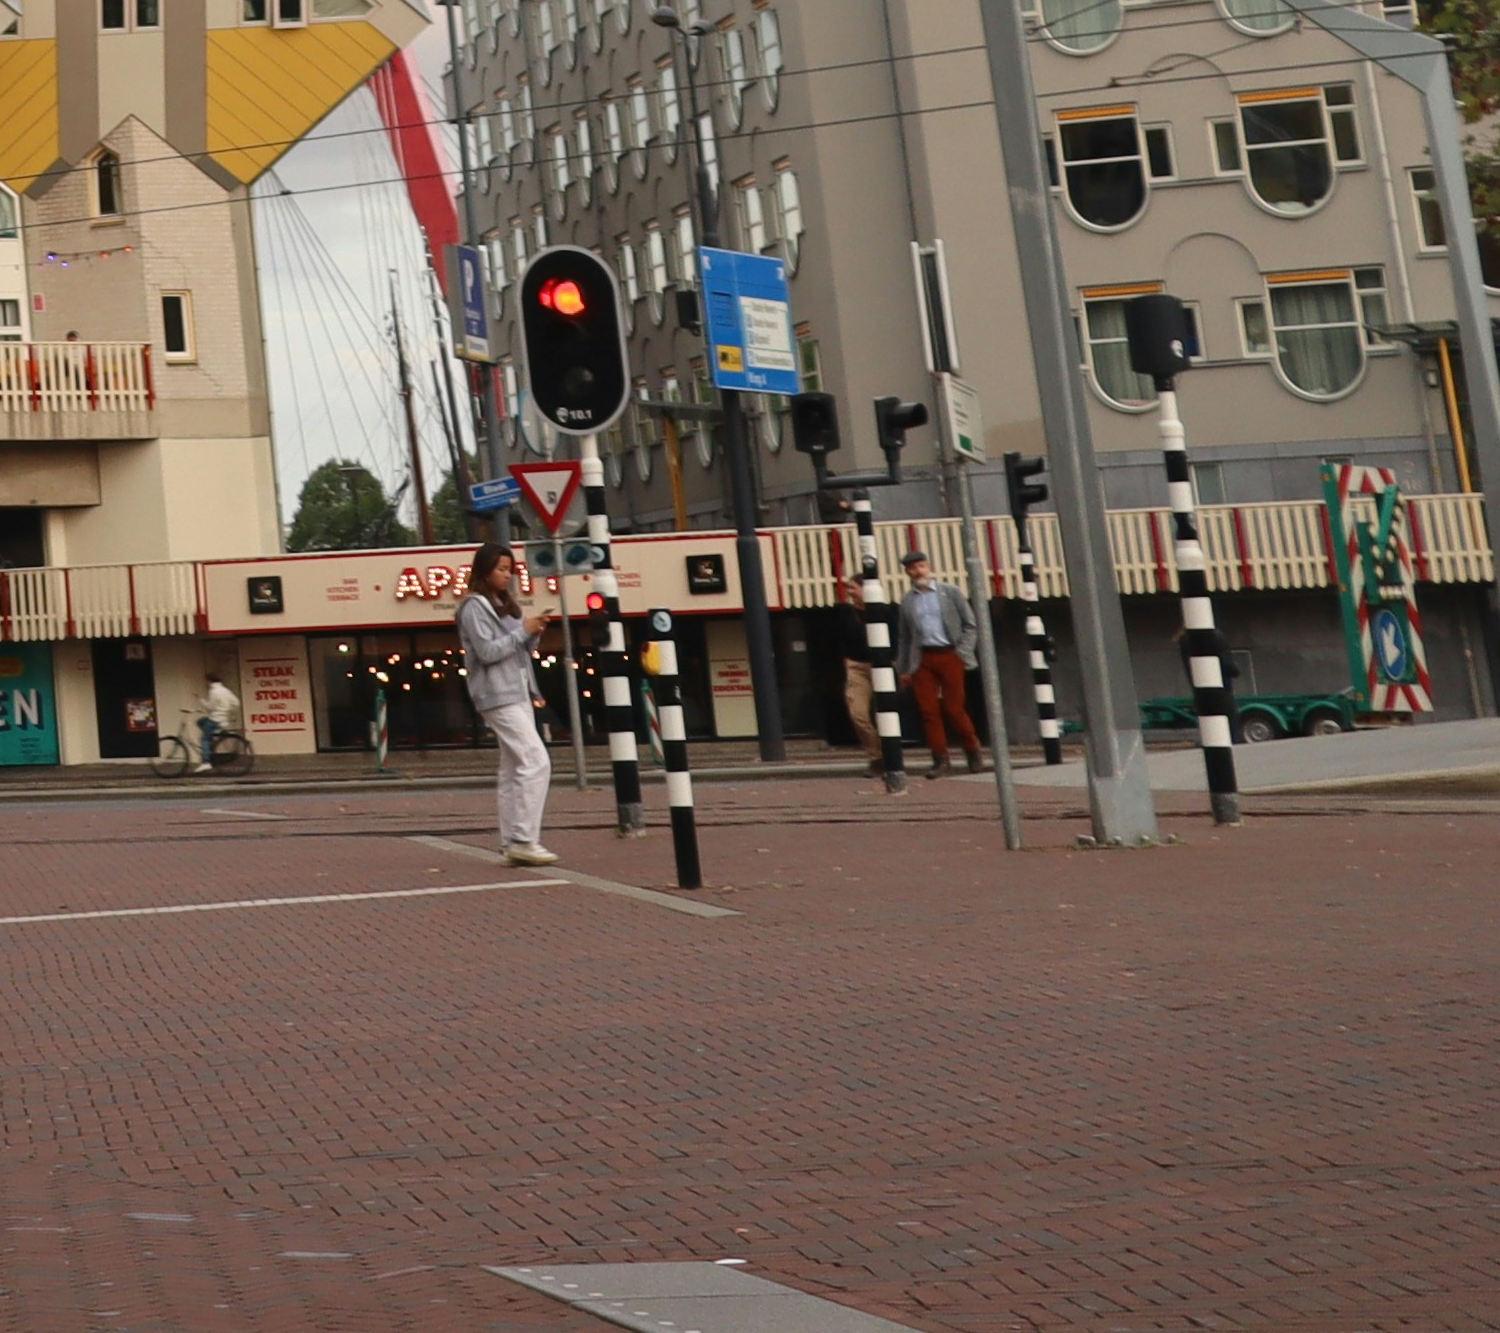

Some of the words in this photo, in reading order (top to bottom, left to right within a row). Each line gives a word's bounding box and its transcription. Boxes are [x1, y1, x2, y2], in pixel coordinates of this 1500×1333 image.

[253, 666, 294, 678] STEAK
[260, 679, 273, 687] ON
[274, 679, 290, 687] THE
[255, 689, 297, 701] STONE
[251, 713, 305, 724] FONDUE
